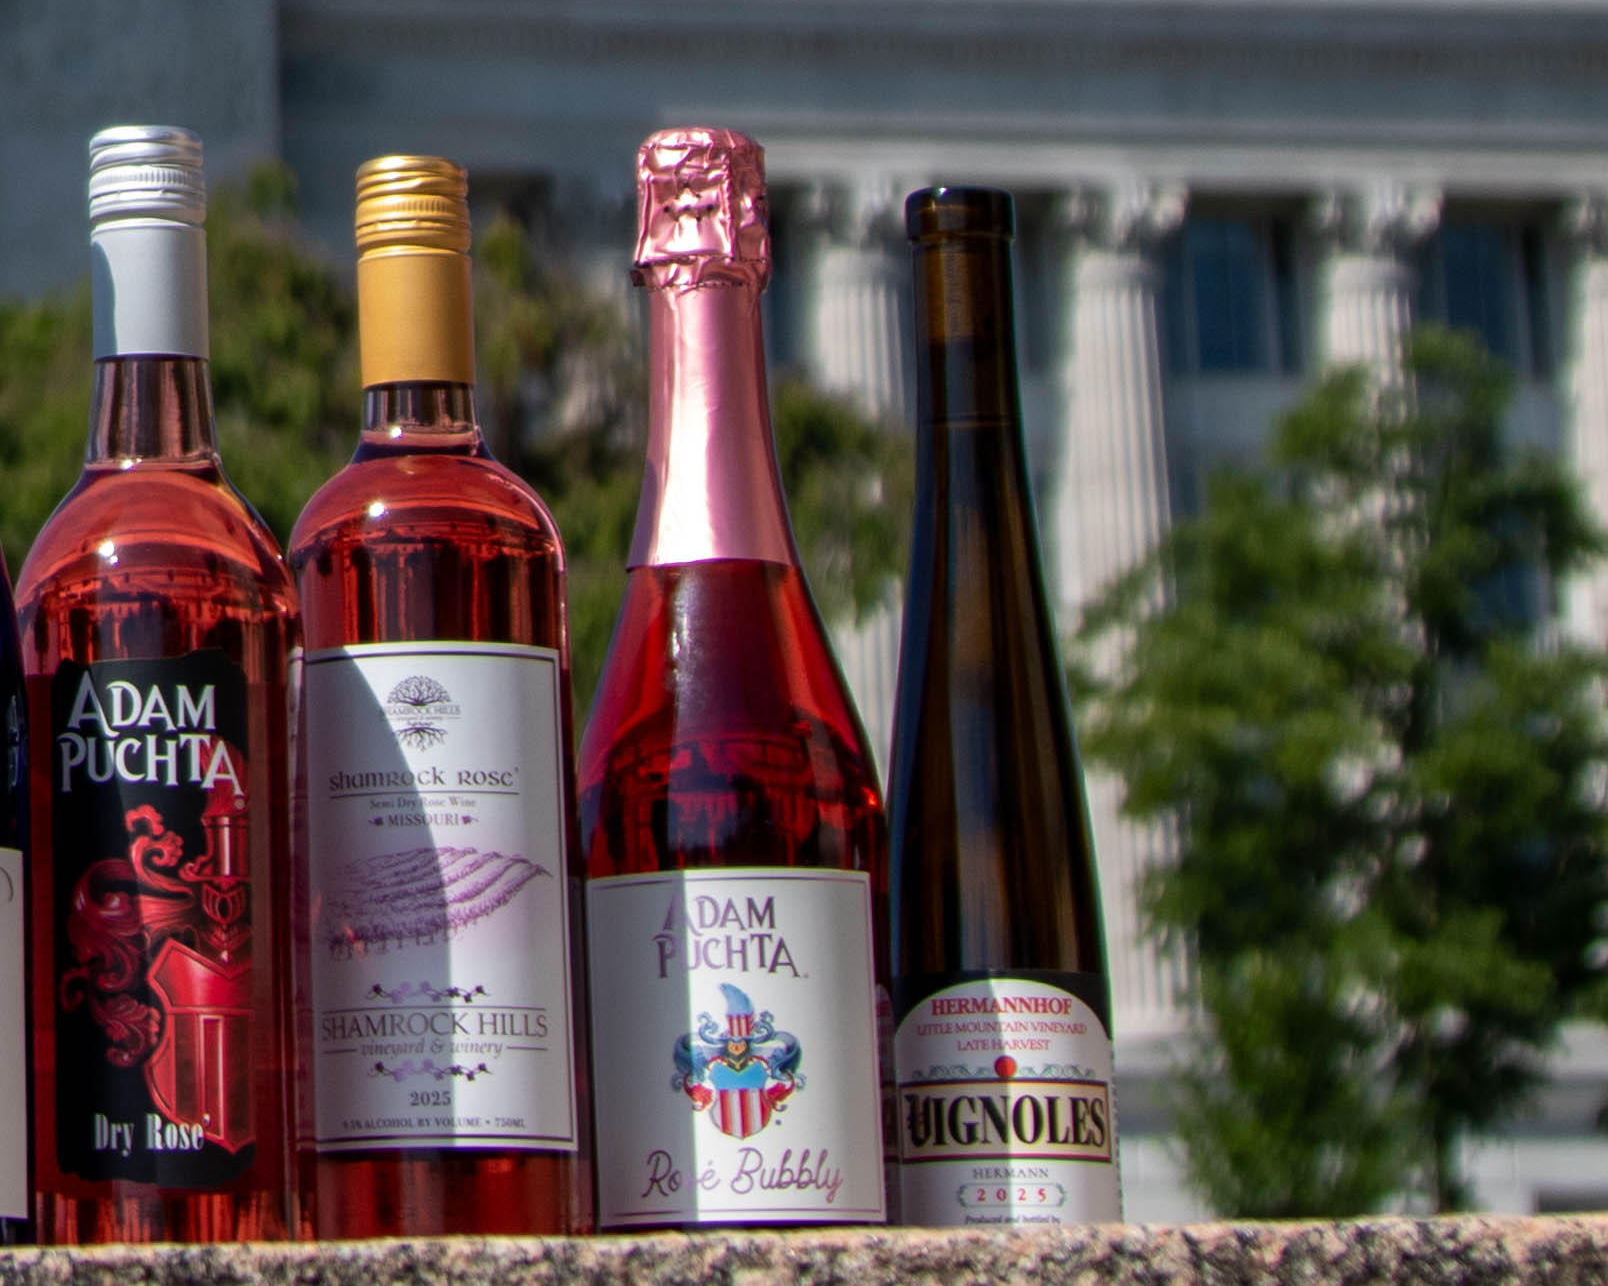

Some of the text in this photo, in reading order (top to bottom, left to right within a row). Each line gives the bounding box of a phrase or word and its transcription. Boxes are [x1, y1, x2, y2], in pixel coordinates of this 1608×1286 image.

[67, 670, 216, 738] ADAM
[57, 732, 244, 796] PUCHTA
[449, 797, 476, 808] Wine
[388, 814, 459, 826] MISSOURI
[663, 893, 776, 936] ADAM
[652, 933, 800, 979] PUCHTA
[931, 997, 1073, 1016] HERMANNHOF
[322, 1012, 548, 1041] SHAMROCK HILLS
[917, 1022, 953, 1036] LITTLE
[956, 1021, 1028, 1035] MOUNTAIN
[361, 1038, 503, 1059] vineyard & winery
[957, 1039, 1051, 1051] LATE HARVEST
[410, 1091, 452, 1106] 2025
[95, 1113, 134, 1157] Dry
[731, 1147, 843, 1203] Bubbly
[973, 1168, 1049, 1179] HERMANN
[977, 1188, 1047, 1202] 2025
